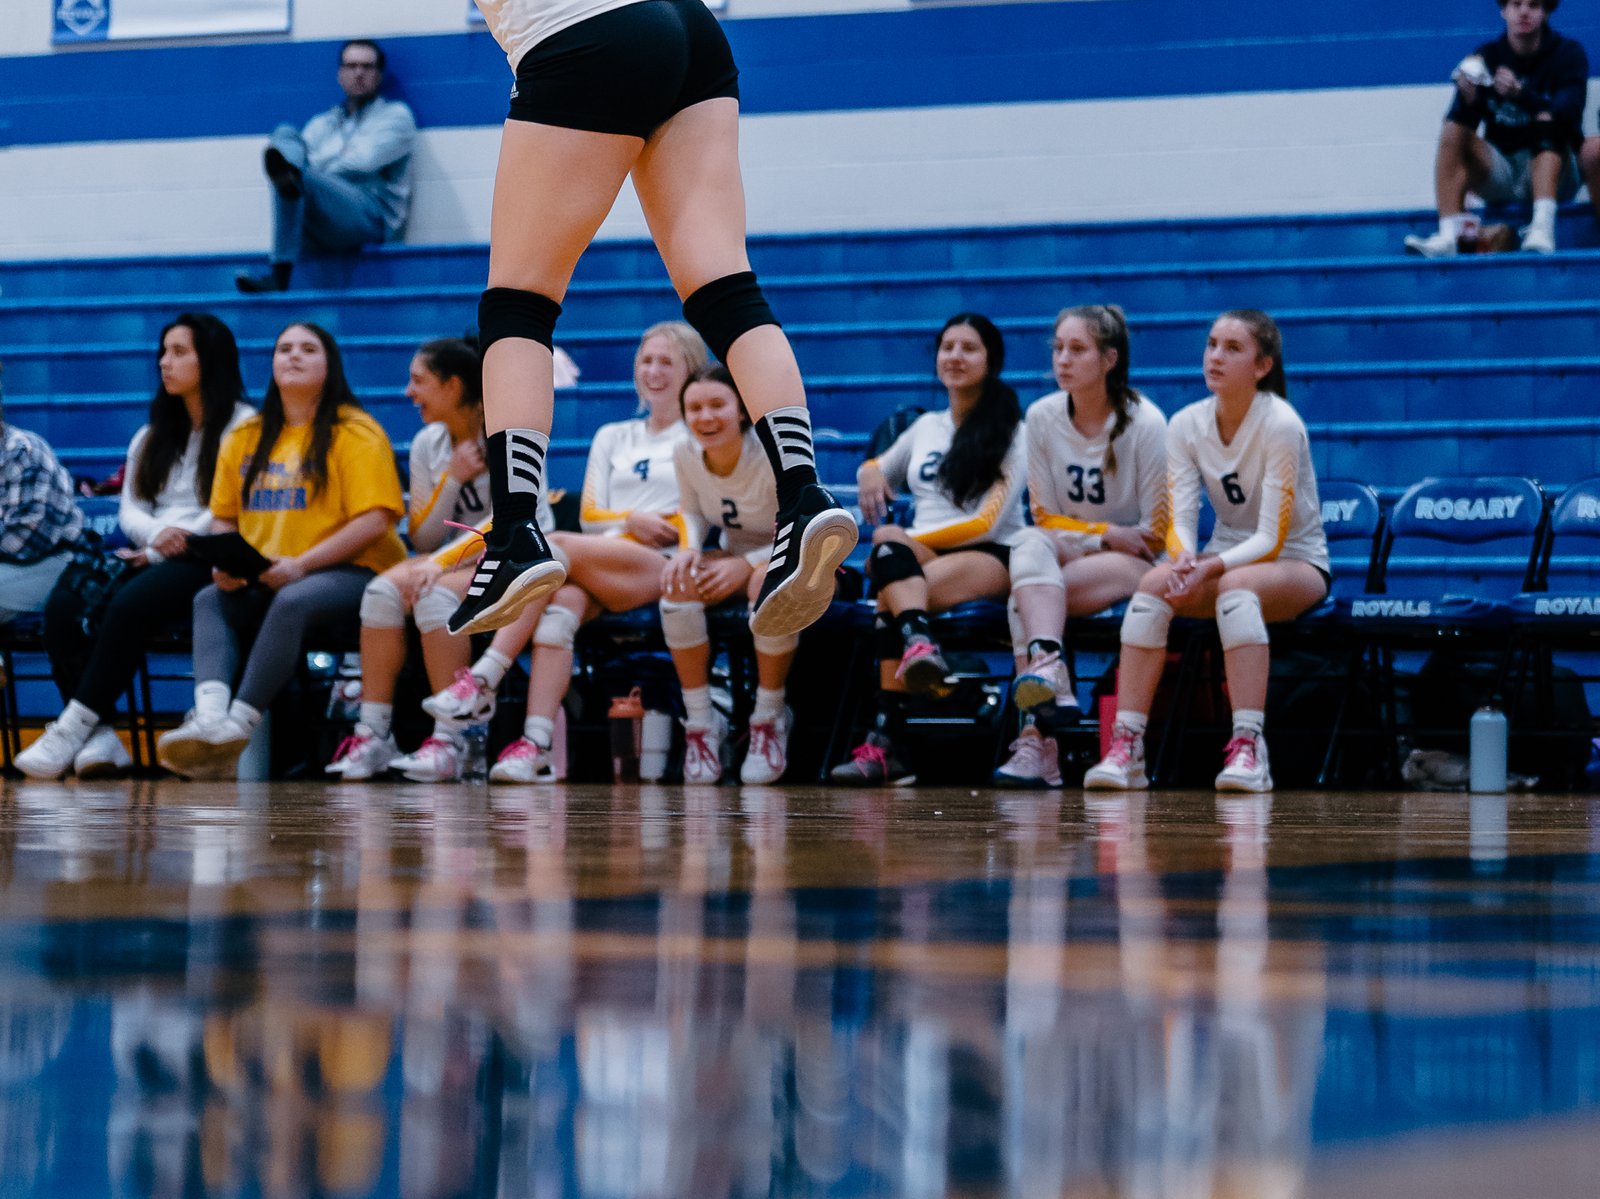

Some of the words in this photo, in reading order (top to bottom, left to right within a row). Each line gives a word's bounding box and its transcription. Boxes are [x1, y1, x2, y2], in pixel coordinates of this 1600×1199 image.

[633, 458, 649, 482] 4
[1067, 464, 1106, 504] 33
[1221, 473, 1246, 505] 6
[721, 498, 742, 529] 2
[1415, 496, 1523, 520] ROSARY
[1352, 600, 1431, 618] ROYALS
